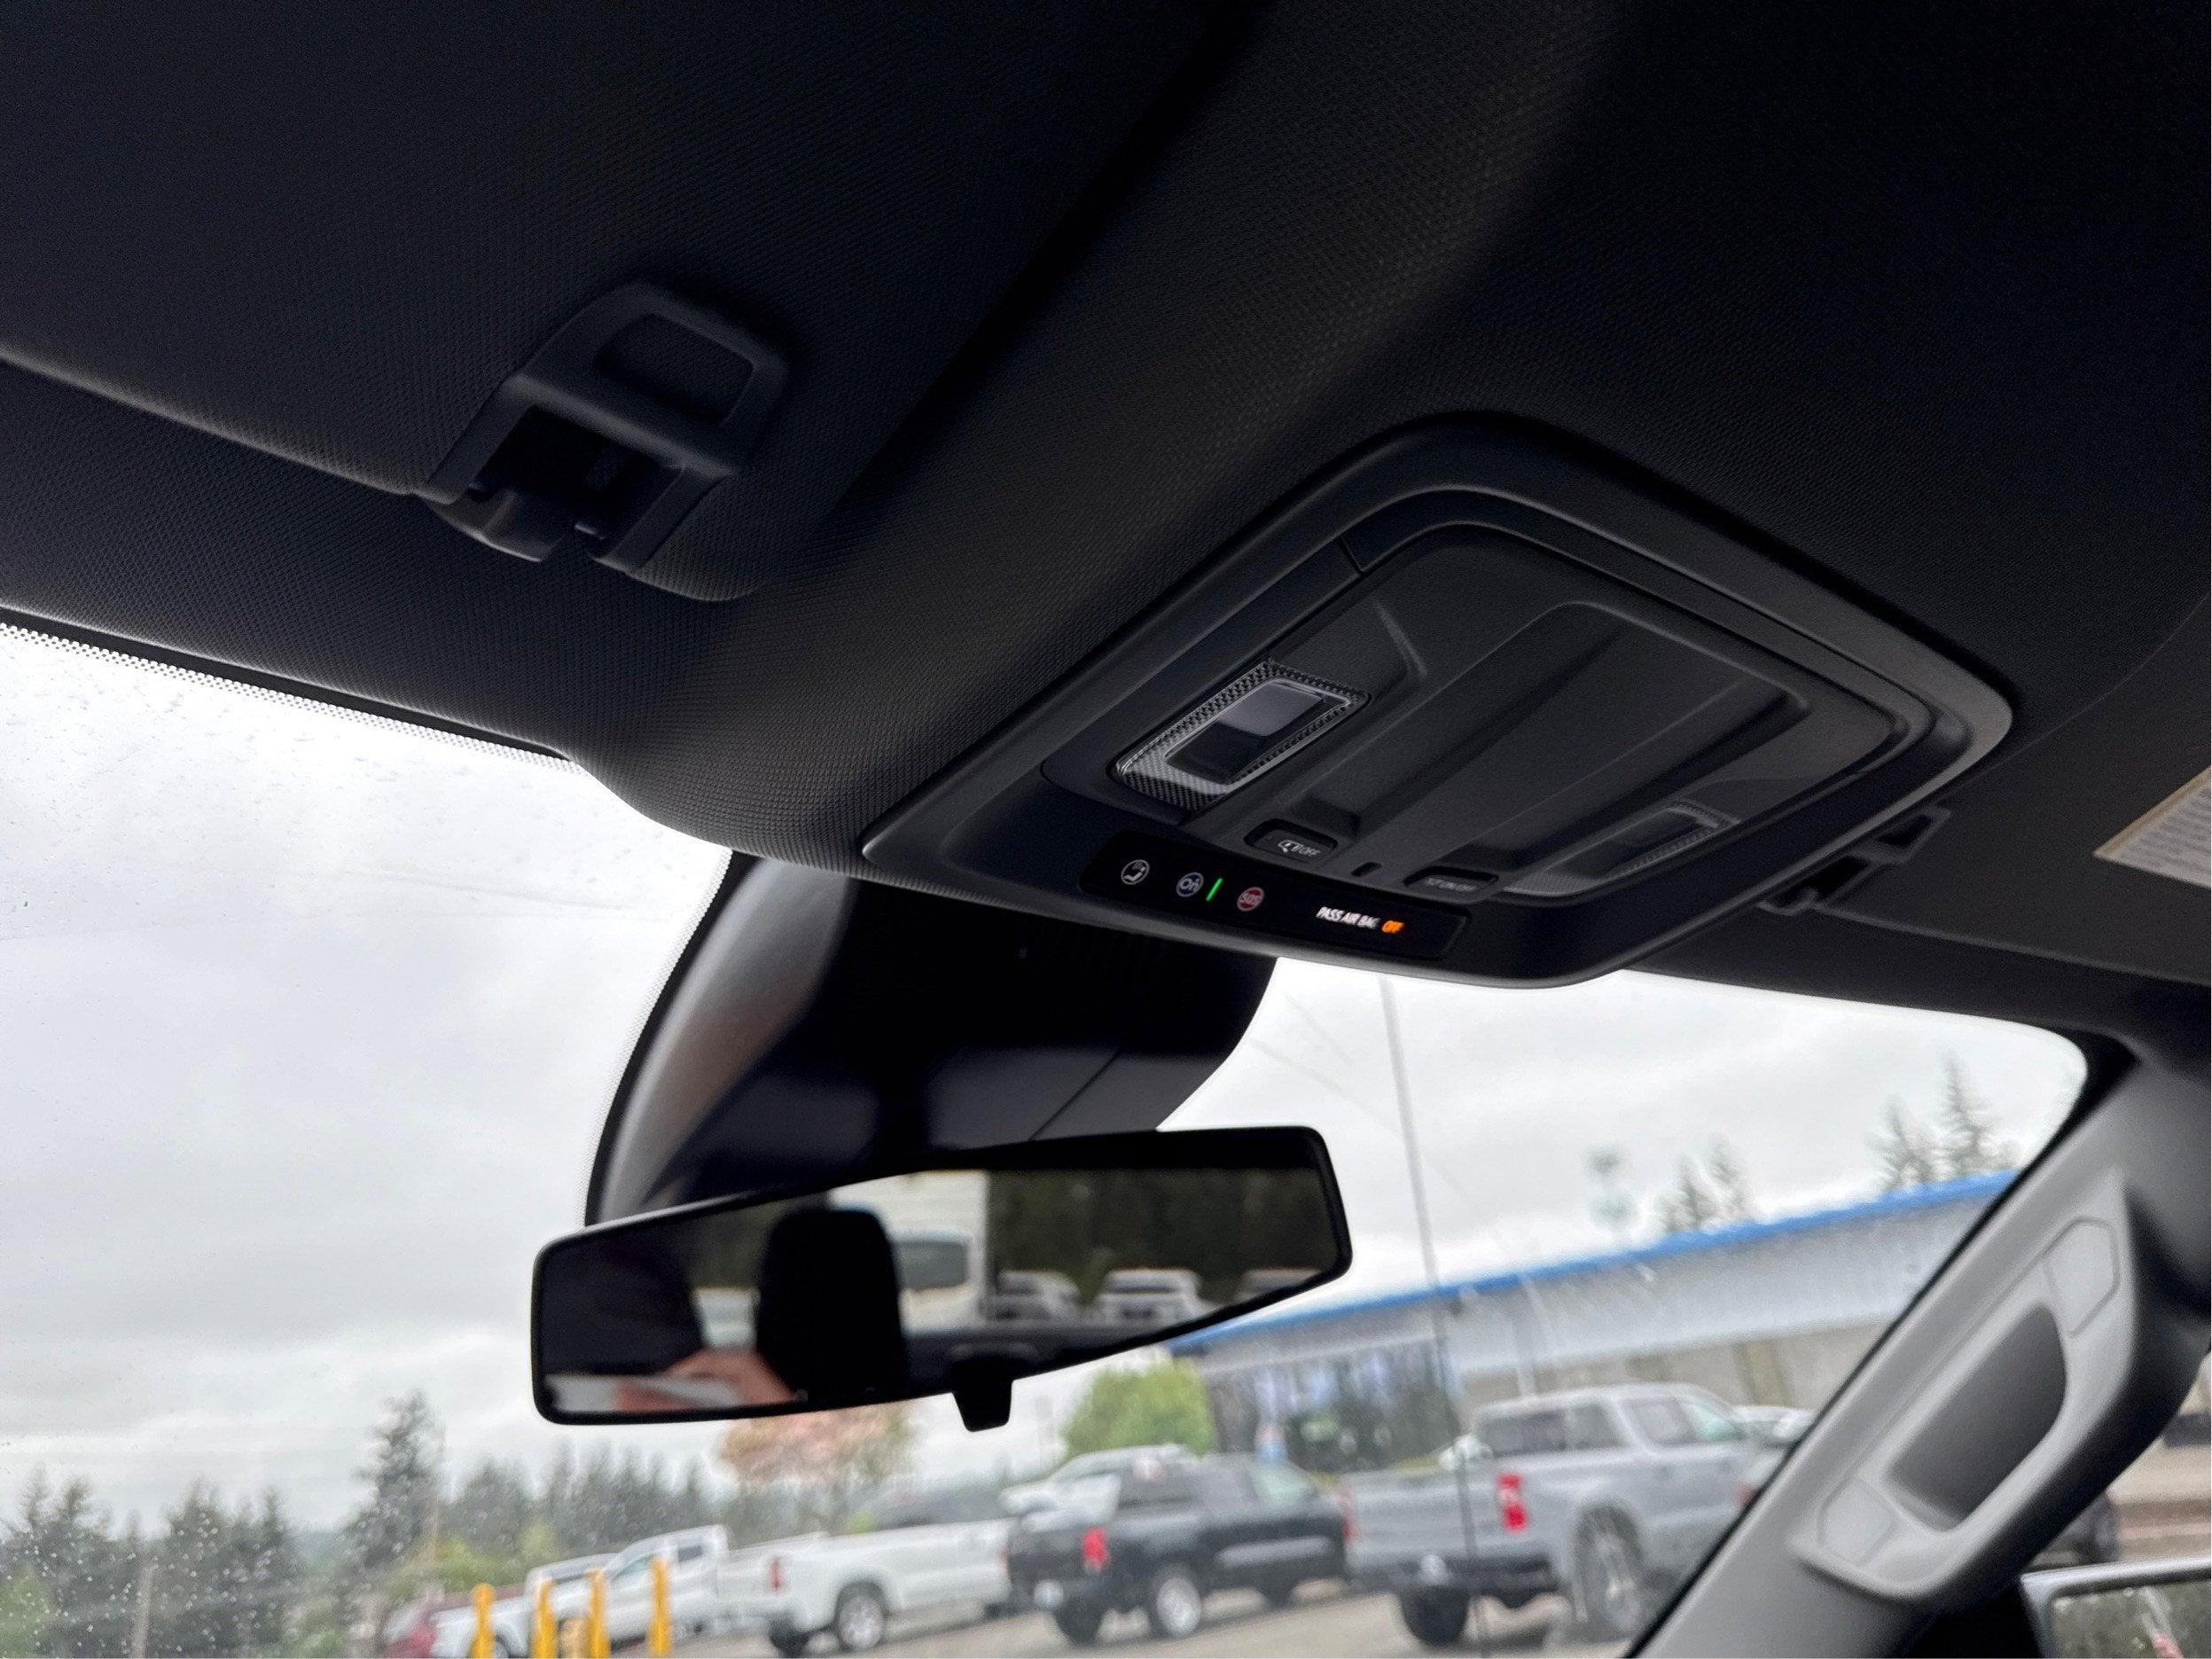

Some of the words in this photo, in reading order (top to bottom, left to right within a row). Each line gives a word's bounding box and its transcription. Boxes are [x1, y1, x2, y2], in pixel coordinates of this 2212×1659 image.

[1239, 892, 1262, 906] SOS
[1316, 906, 1345, 922] PASS
[1340, 912, 1361, 925] AIR
[1381, 919, 1405, 934] OFF
